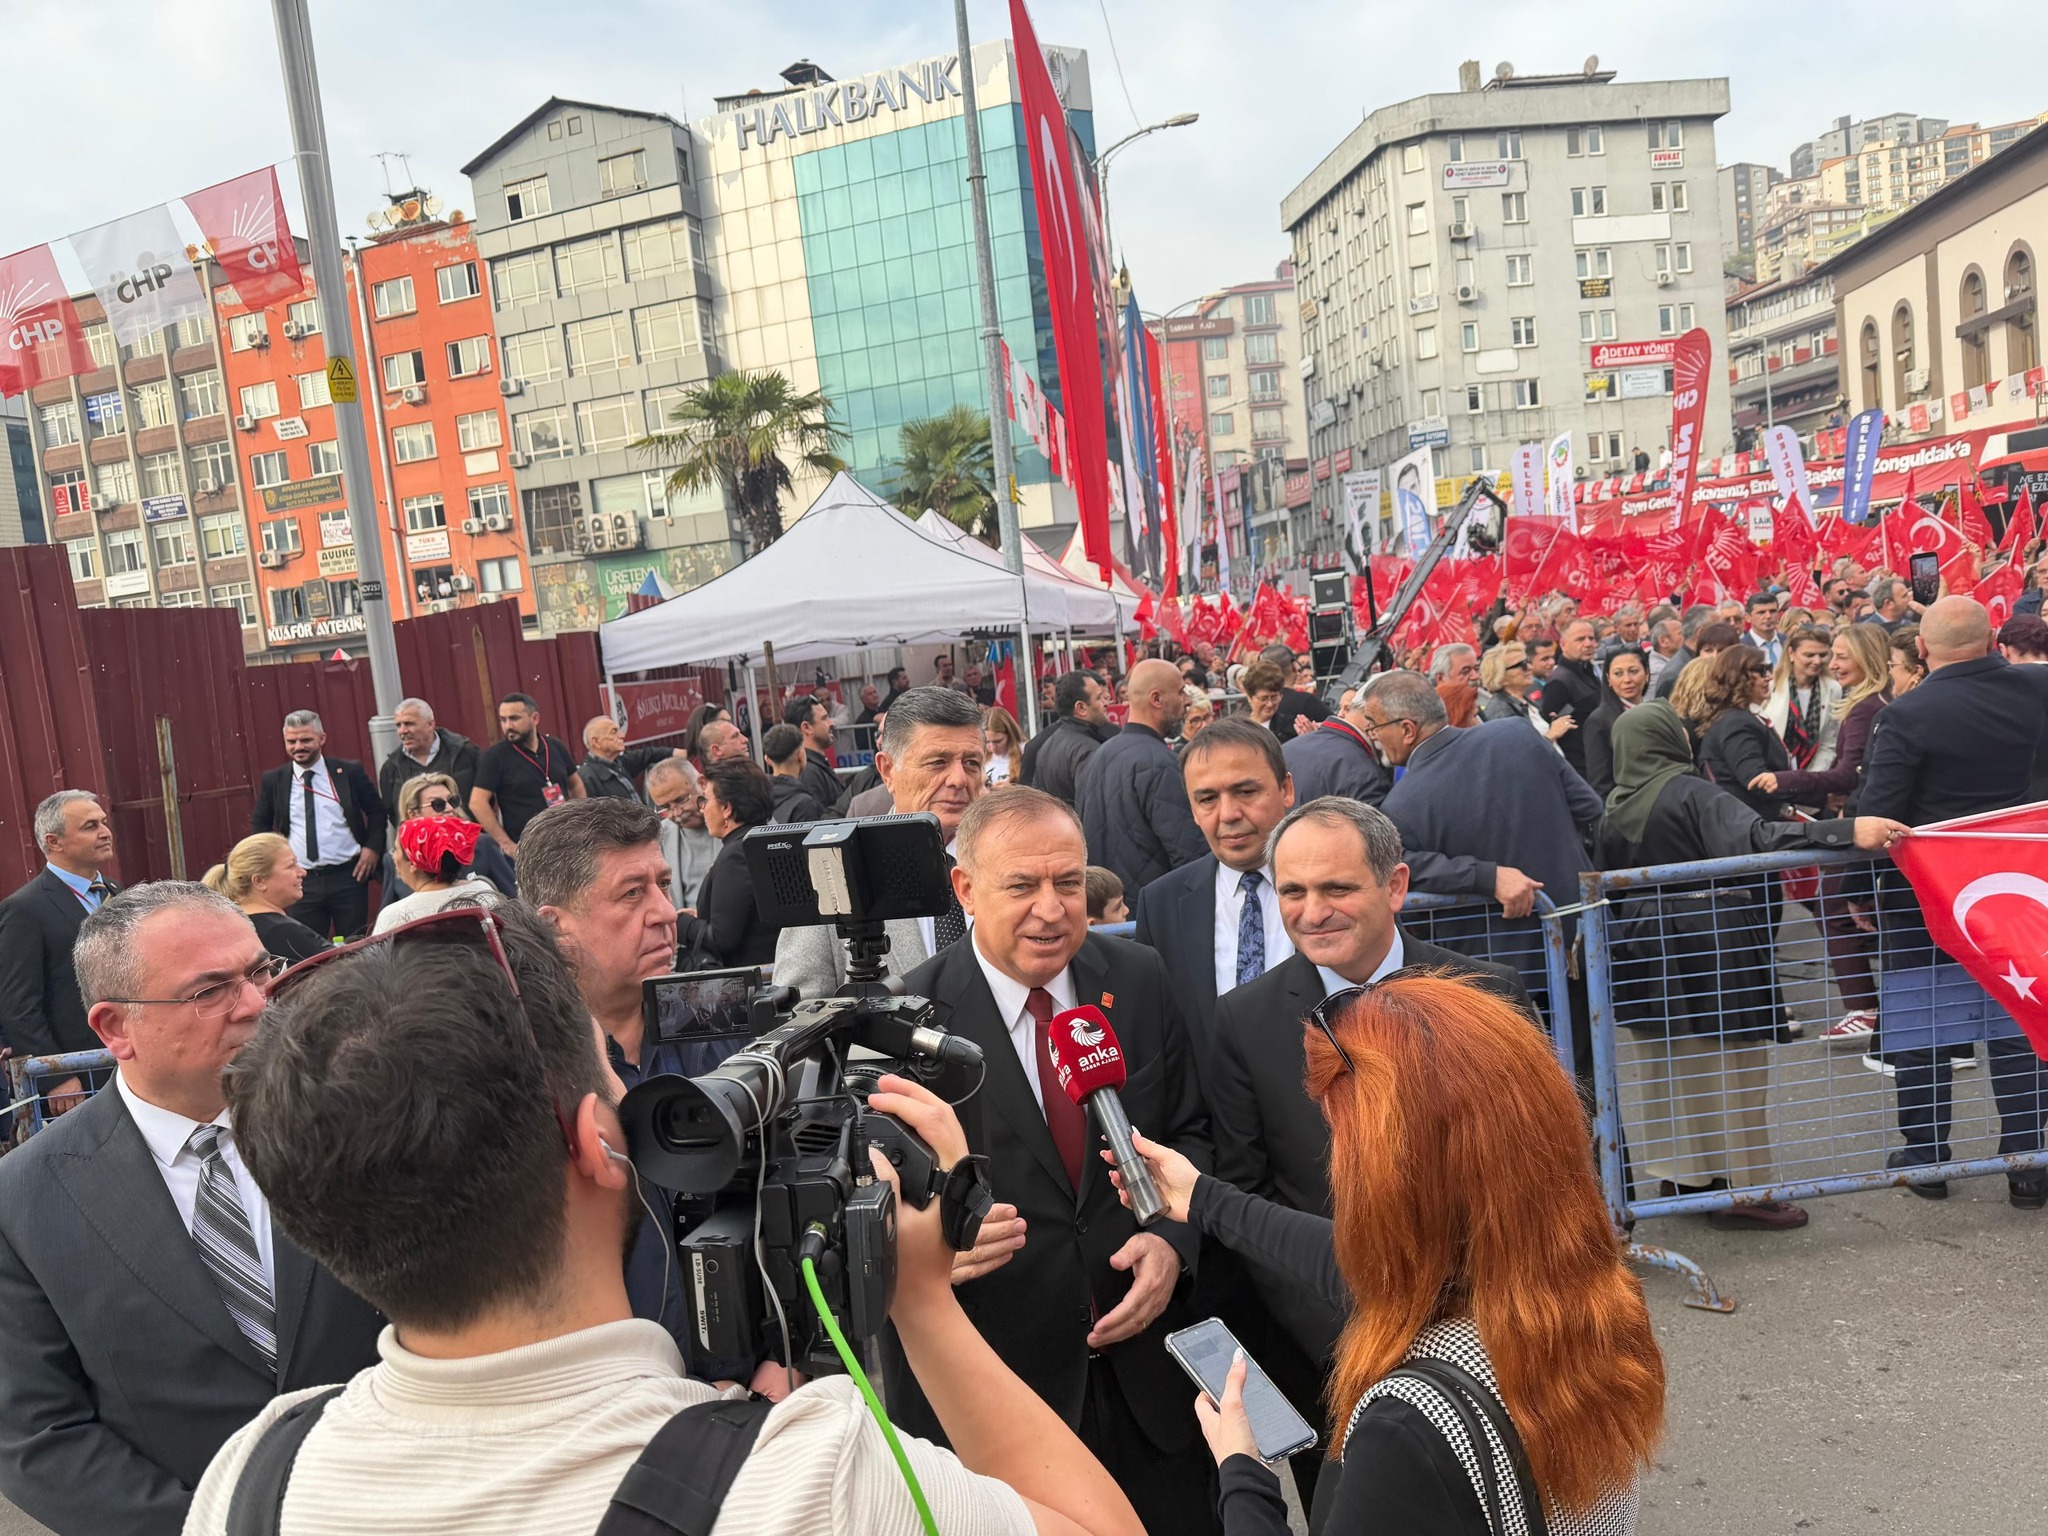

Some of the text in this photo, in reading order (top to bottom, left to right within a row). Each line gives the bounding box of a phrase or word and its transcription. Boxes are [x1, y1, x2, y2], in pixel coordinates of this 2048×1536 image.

[735, 56, 962, 149] HALKBANK
[247, 240, 298, 270] CH
[117, 263, 173, 303] CHP
[8, 319, 62, 350] CHP
[1610, 342, 1675, 358] DETAY YÖNET
[1621, 500, 1647, 517] Sayın
[1648, 496, 1677, 511] Gene
[1692, 483, 1749, 506] şkanımız,
[1804, 466, 1845, 489] Başke
[1873, 440, 1971, 475] Zonguldak'a
[2037, 472, 2048, 482] EZ
[322, 548, 356, 560] AVUKA
[607, 581, 641, 596] YANIND
[1568, 571, 1590, 590] CH
[268, 622, 313, 642] KUAFÖR
[837, 752, 872, 768] OLİS
[1078, 1046, 1118, 1067] anka
[1082, 1062, 1100, 1072] HABER
